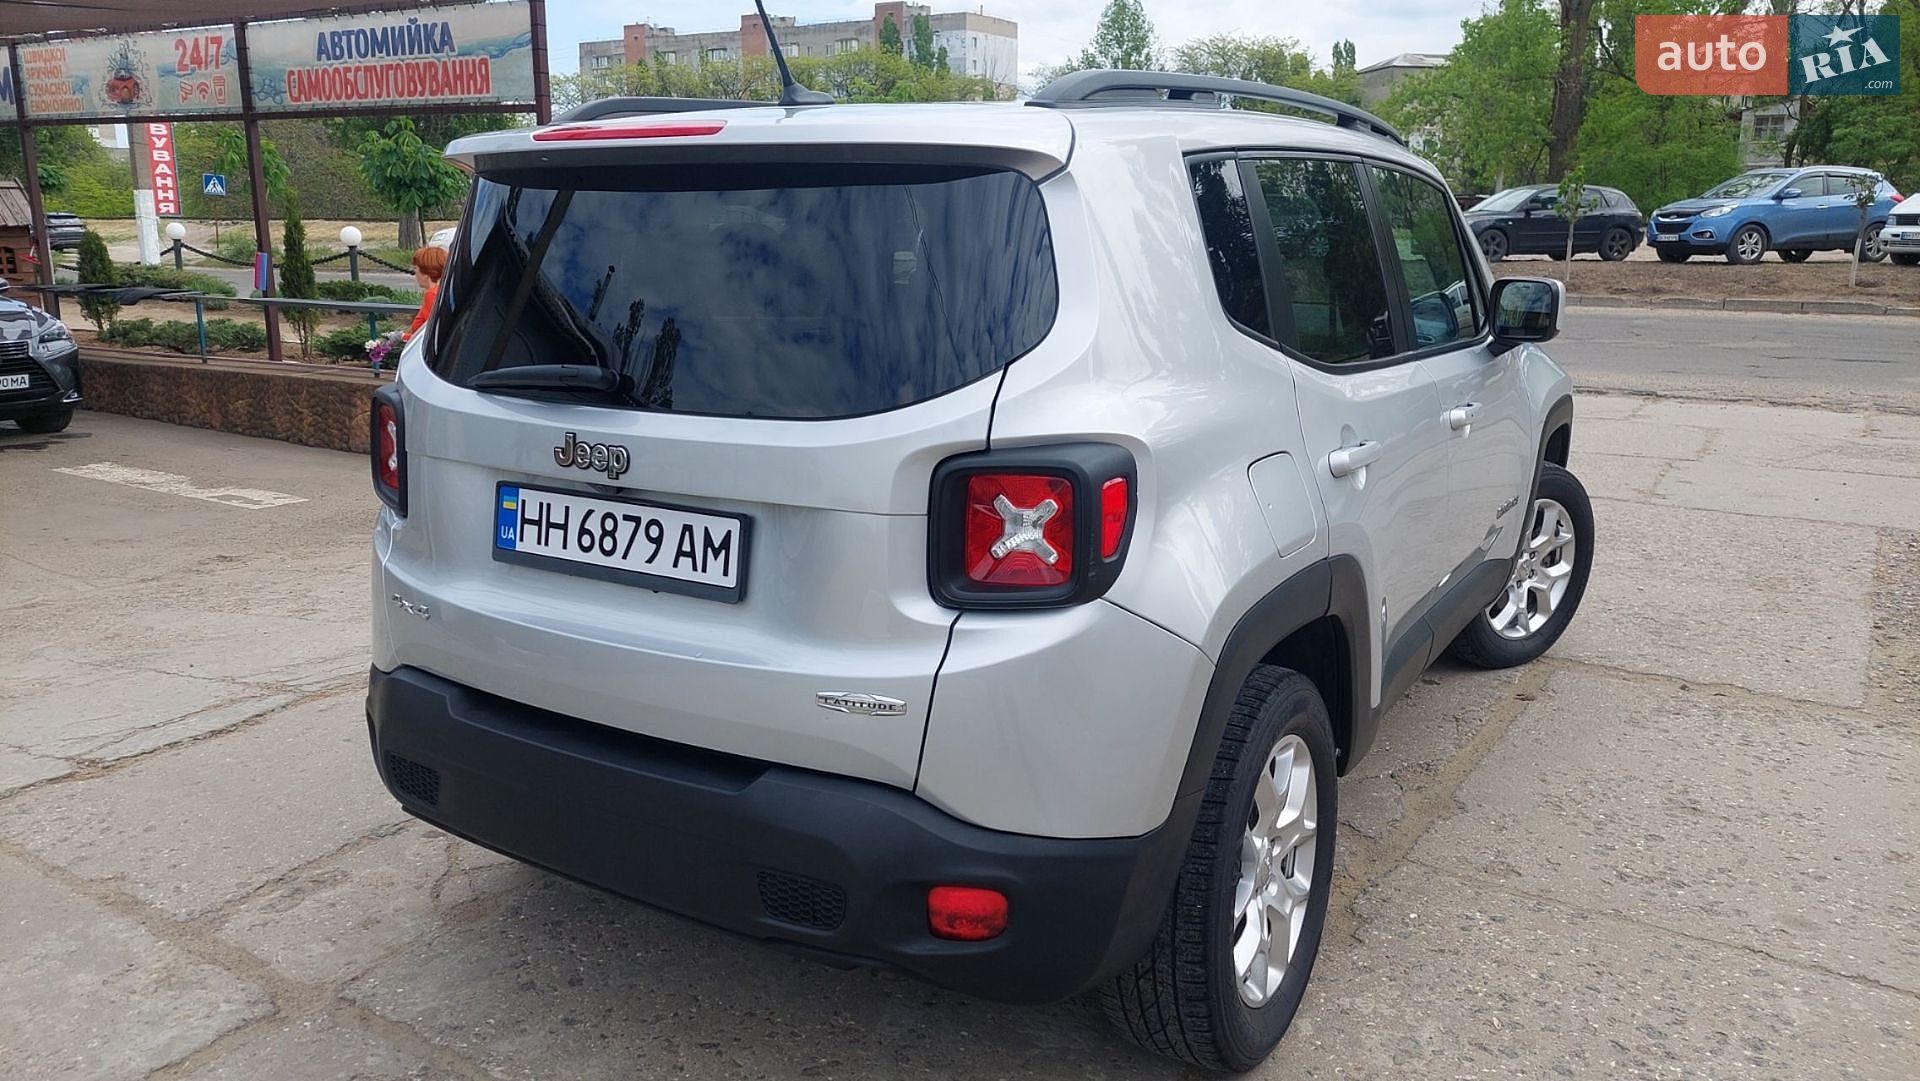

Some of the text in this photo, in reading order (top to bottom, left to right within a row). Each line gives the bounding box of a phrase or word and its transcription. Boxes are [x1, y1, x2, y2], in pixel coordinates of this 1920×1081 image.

[175, 36, 223, 72] 24/7
[316, 17, 456, 62] АВТОМИЙКА
[286, 57, 491, 104] САМООБСЛУГОВУВАННЯ
[554, 431, 630, 480] Jeep
[501, 525, 515, 541] UA
[824, 697, 897, 711] LATITUDE
